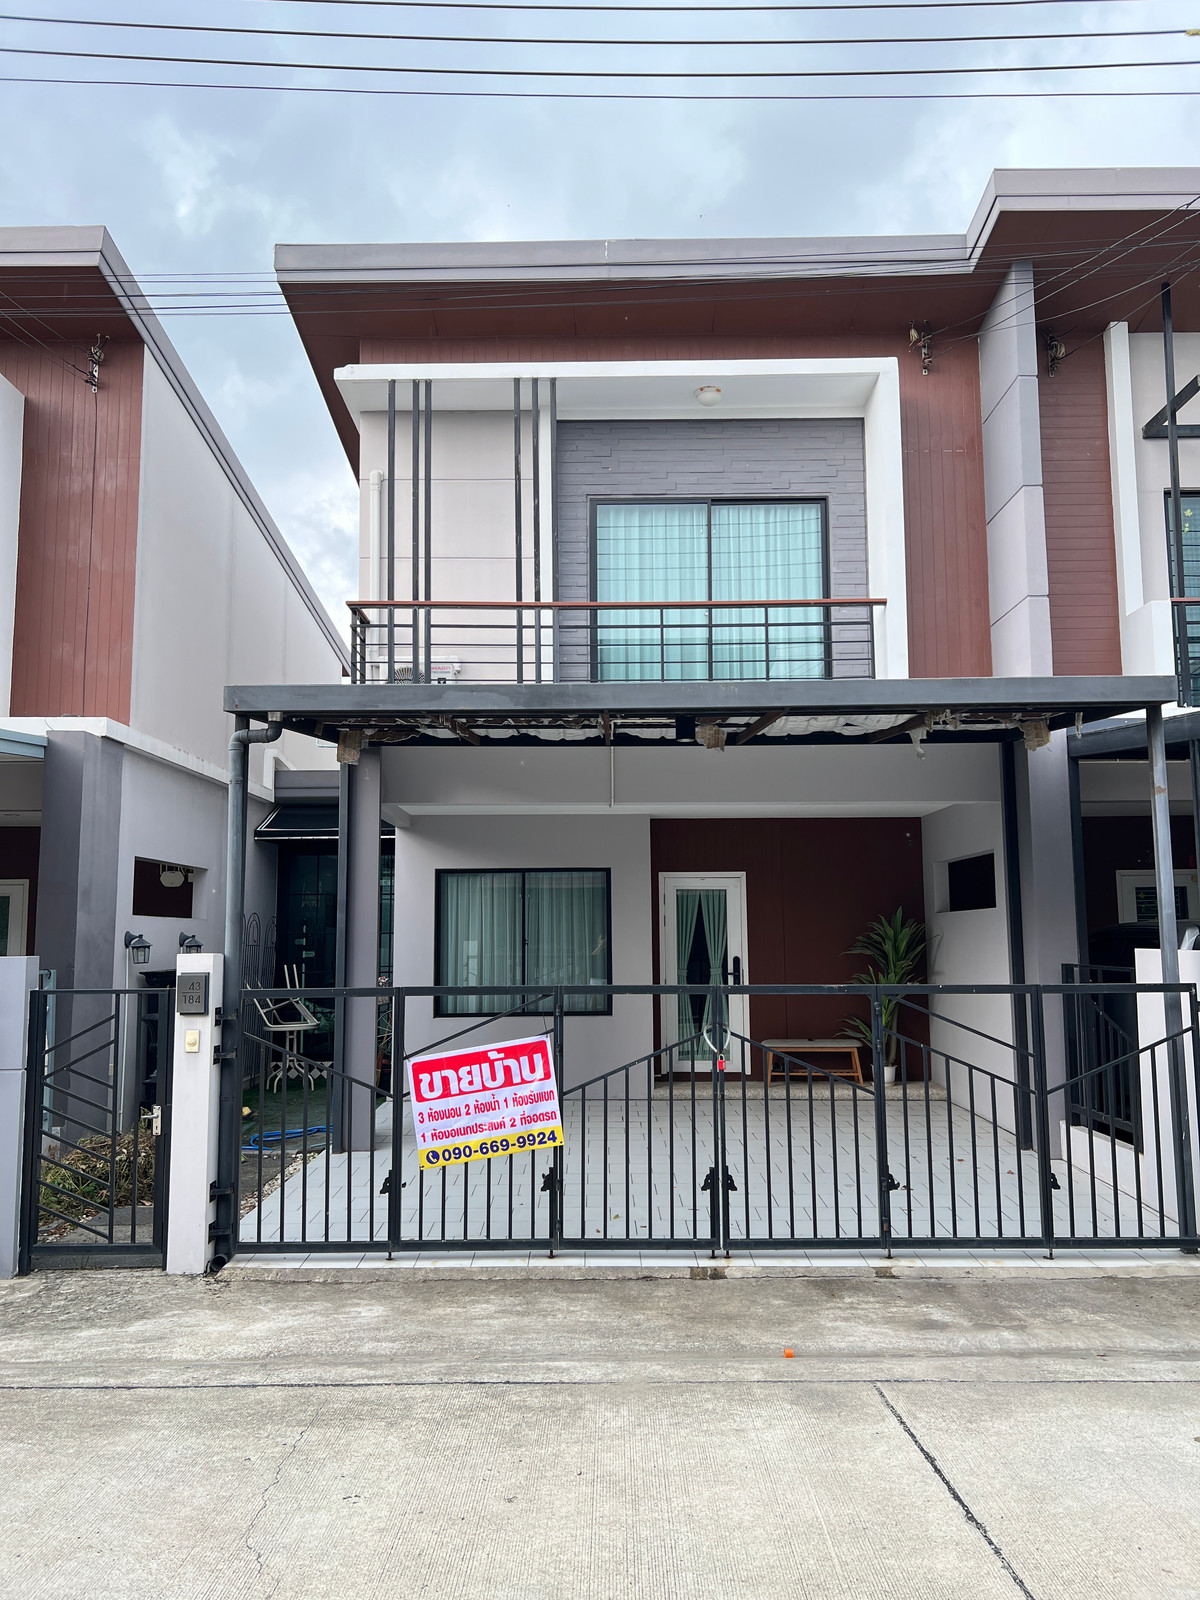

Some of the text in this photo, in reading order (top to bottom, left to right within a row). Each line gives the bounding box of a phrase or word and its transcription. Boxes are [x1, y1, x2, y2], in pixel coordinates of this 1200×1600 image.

[182, 995, 201, 1004] 184
[189, 982, 201, 991] 43
[418, 1050, 545, 1099] ขายบ้าน
[418, 1090, 555, 1124] 3 ห้องนอน 2 ห้องน้ำ 1 ห้องรับแขก
[421, 1111, 557, 1143] 1 ห้องอเนกประสงค์ 2 ที่จอดรถ
[441, 1130, 557, 1162] 090-669-9924
